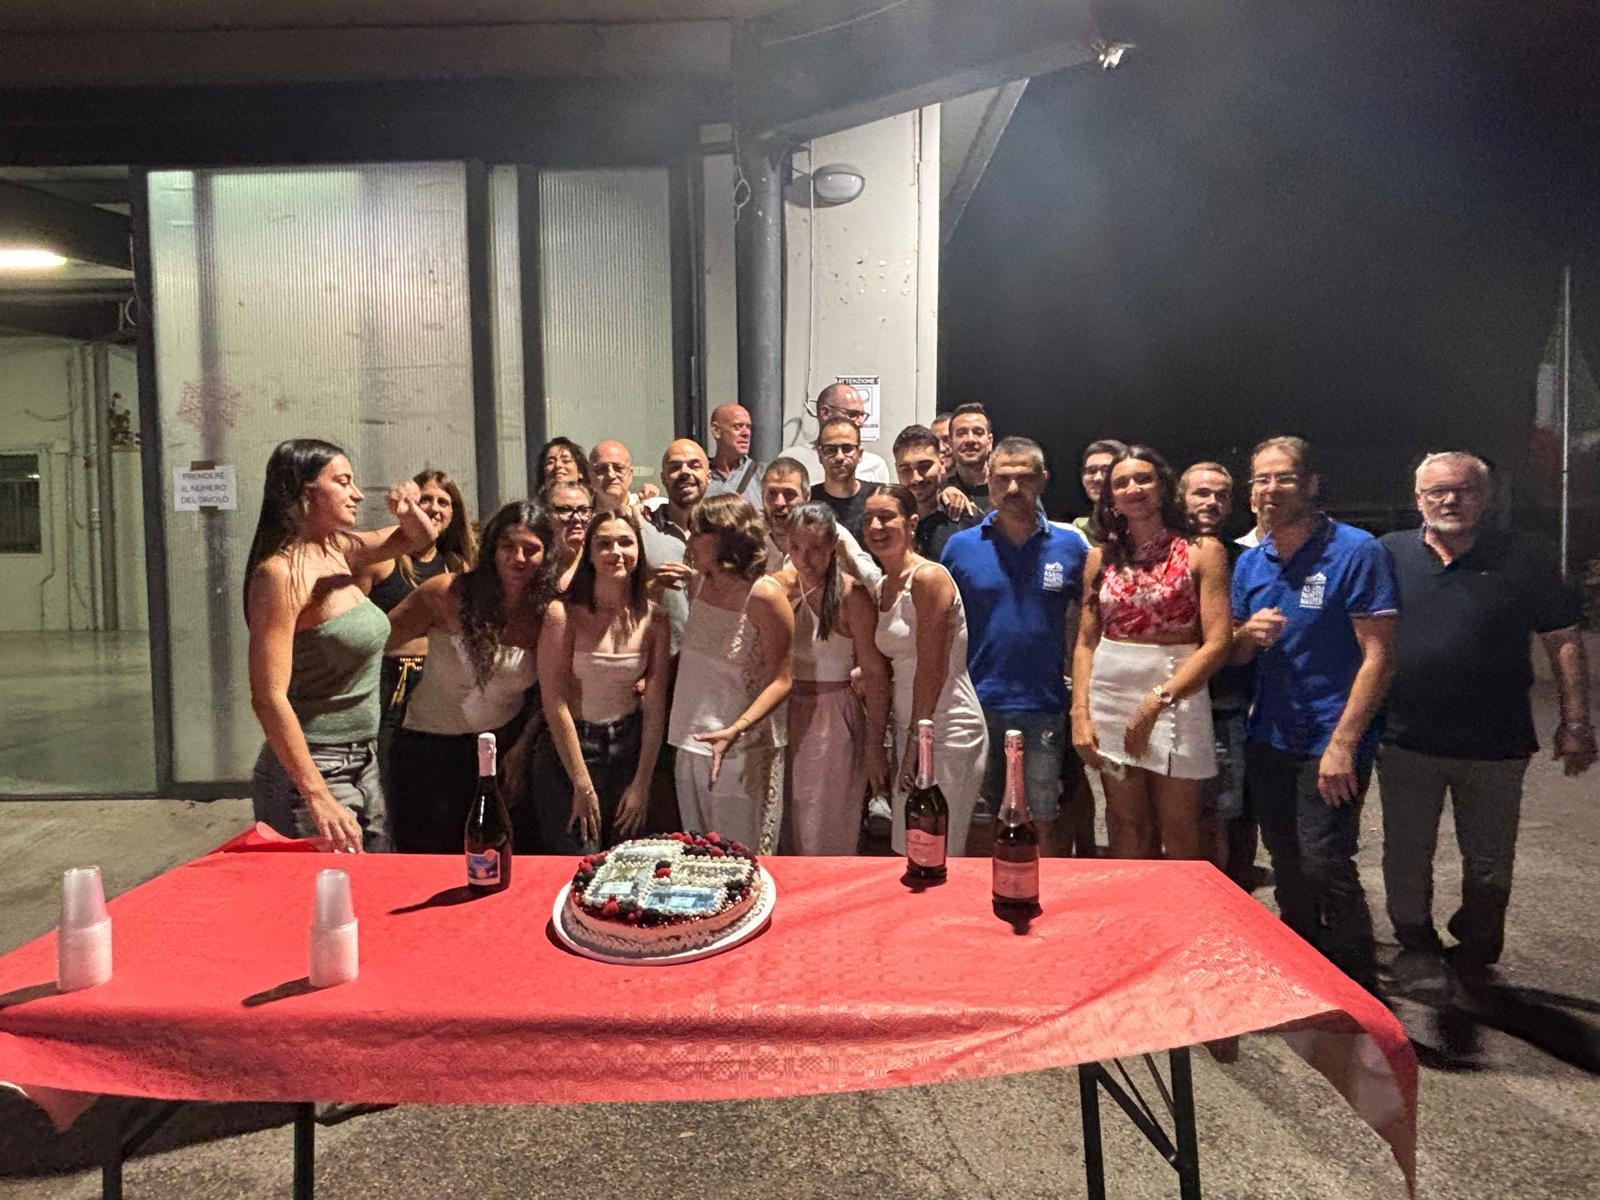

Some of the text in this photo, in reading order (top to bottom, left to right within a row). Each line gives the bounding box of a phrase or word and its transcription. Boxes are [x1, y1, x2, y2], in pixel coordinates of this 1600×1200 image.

[182, 472, 225, 480] PRENDERE
[182, 485, 189, 493] IL
[181, 496, 197, 504] DEL
